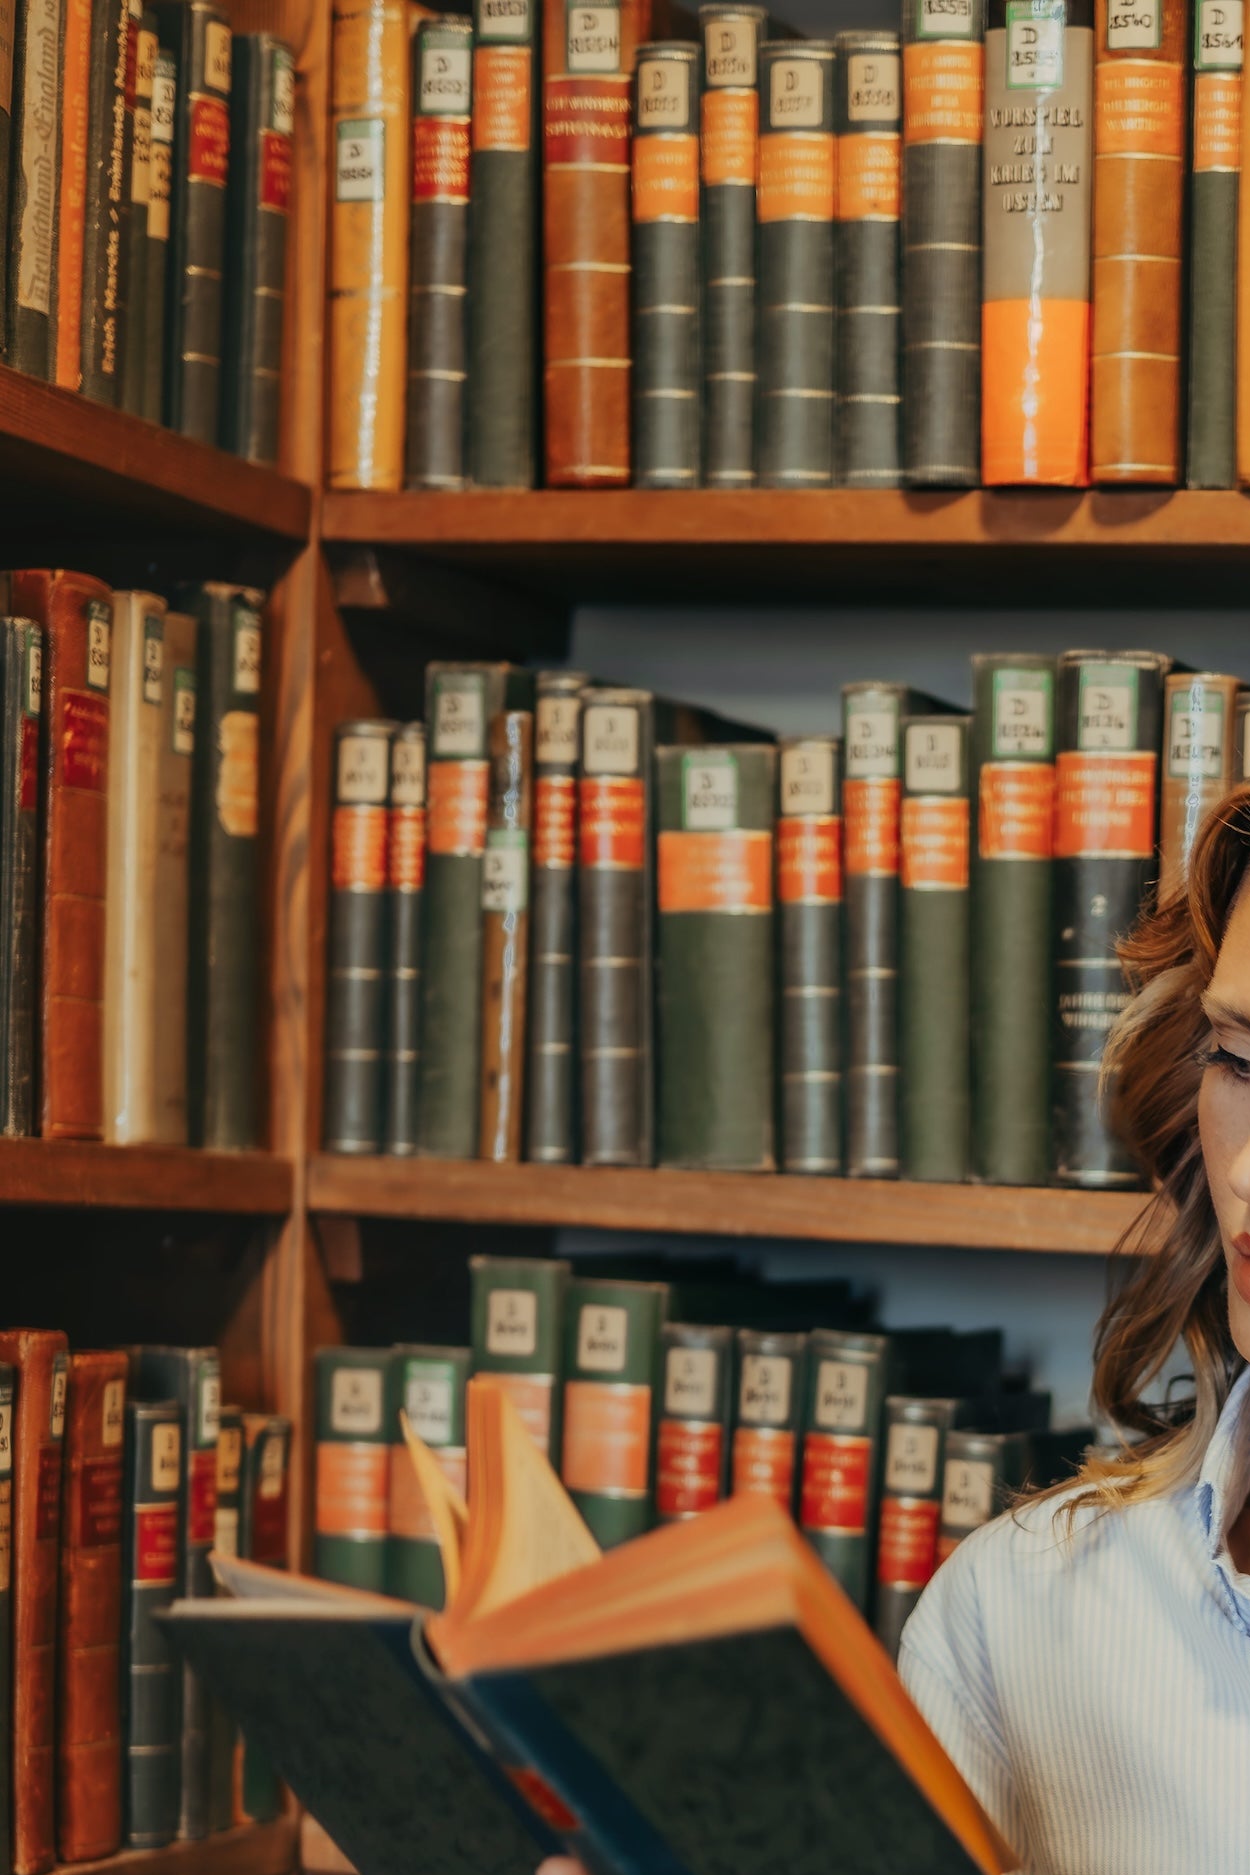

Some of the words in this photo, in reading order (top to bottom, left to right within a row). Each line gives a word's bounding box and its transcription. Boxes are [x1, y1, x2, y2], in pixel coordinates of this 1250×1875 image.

[1211, 9, 1226, 26] D
[1020, 27, 1037, 45] D
[1054, 163, 1079, 185] IM
